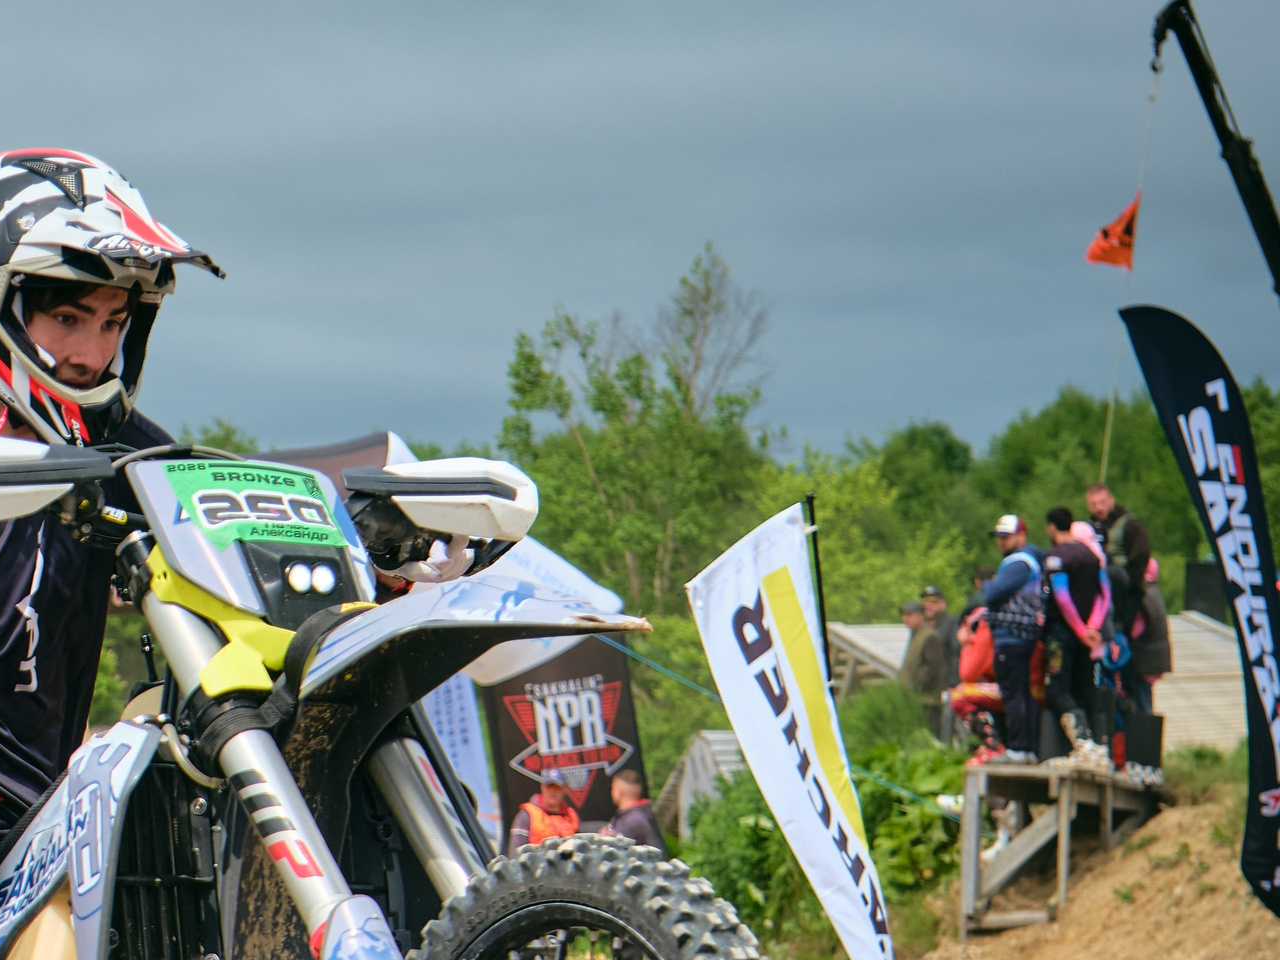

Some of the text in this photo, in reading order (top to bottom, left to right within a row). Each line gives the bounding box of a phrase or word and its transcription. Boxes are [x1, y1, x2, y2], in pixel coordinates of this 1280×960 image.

[70, 417, 85, 448] Airo
[211, 471, 296, 487] BRONZE
[192, 489, 337, 529] 250
[250, 526, 329, 541] Александр
